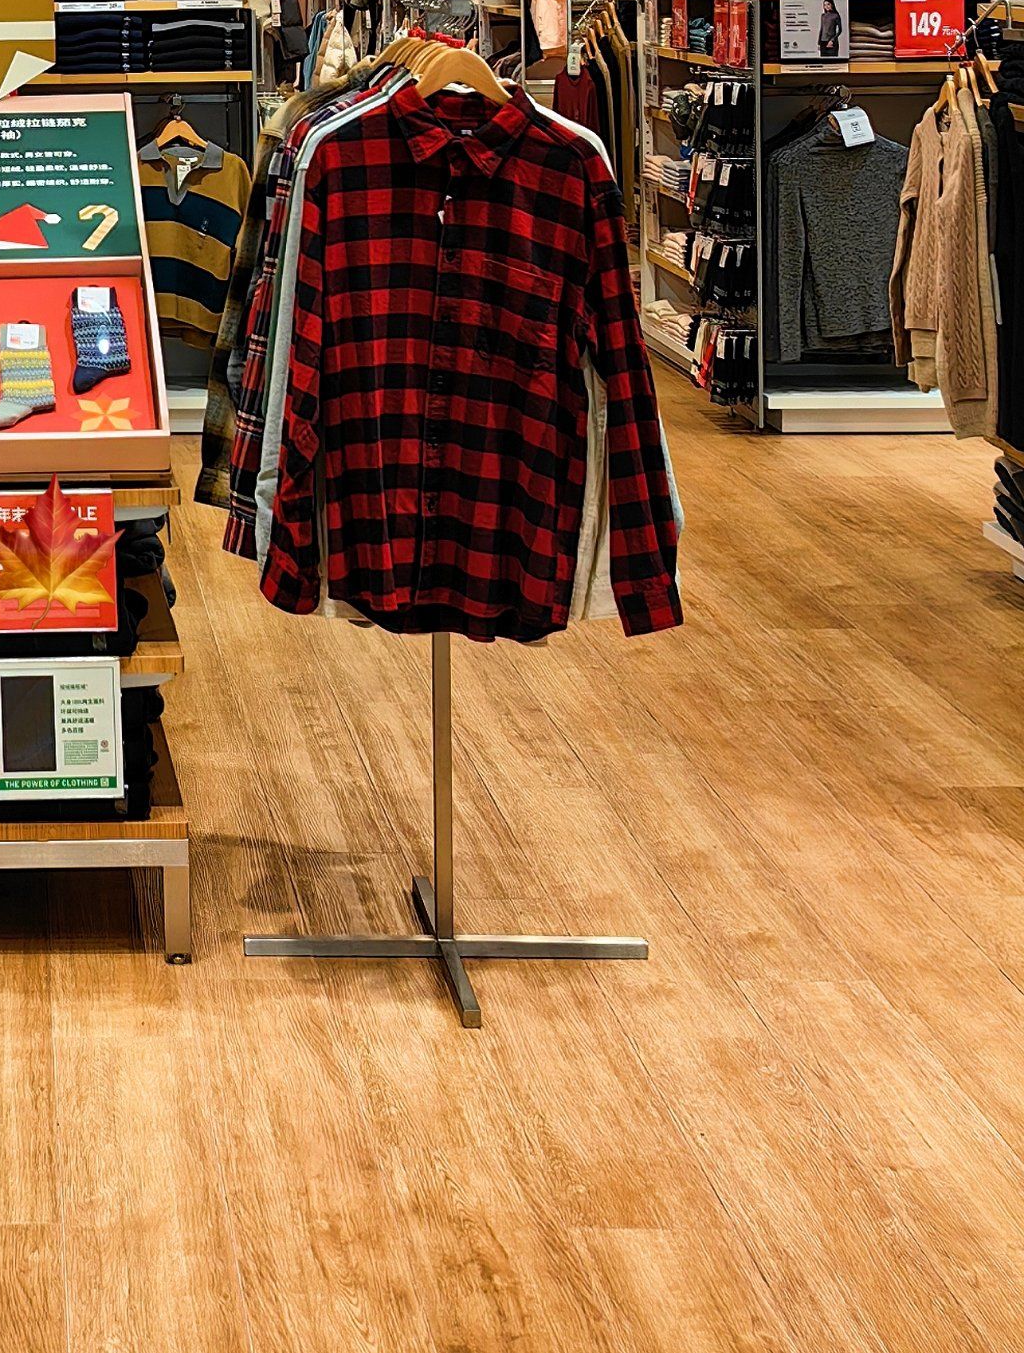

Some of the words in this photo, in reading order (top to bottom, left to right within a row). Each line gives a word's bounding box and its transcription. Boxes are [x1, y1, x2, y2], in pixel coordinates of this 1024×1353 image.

[5, 780, 19, 788] THE
[21, 780, 48, 788] POWER
[50, 779, 60, 787] OF
[61, 779, 98, 787] CLOTHING
